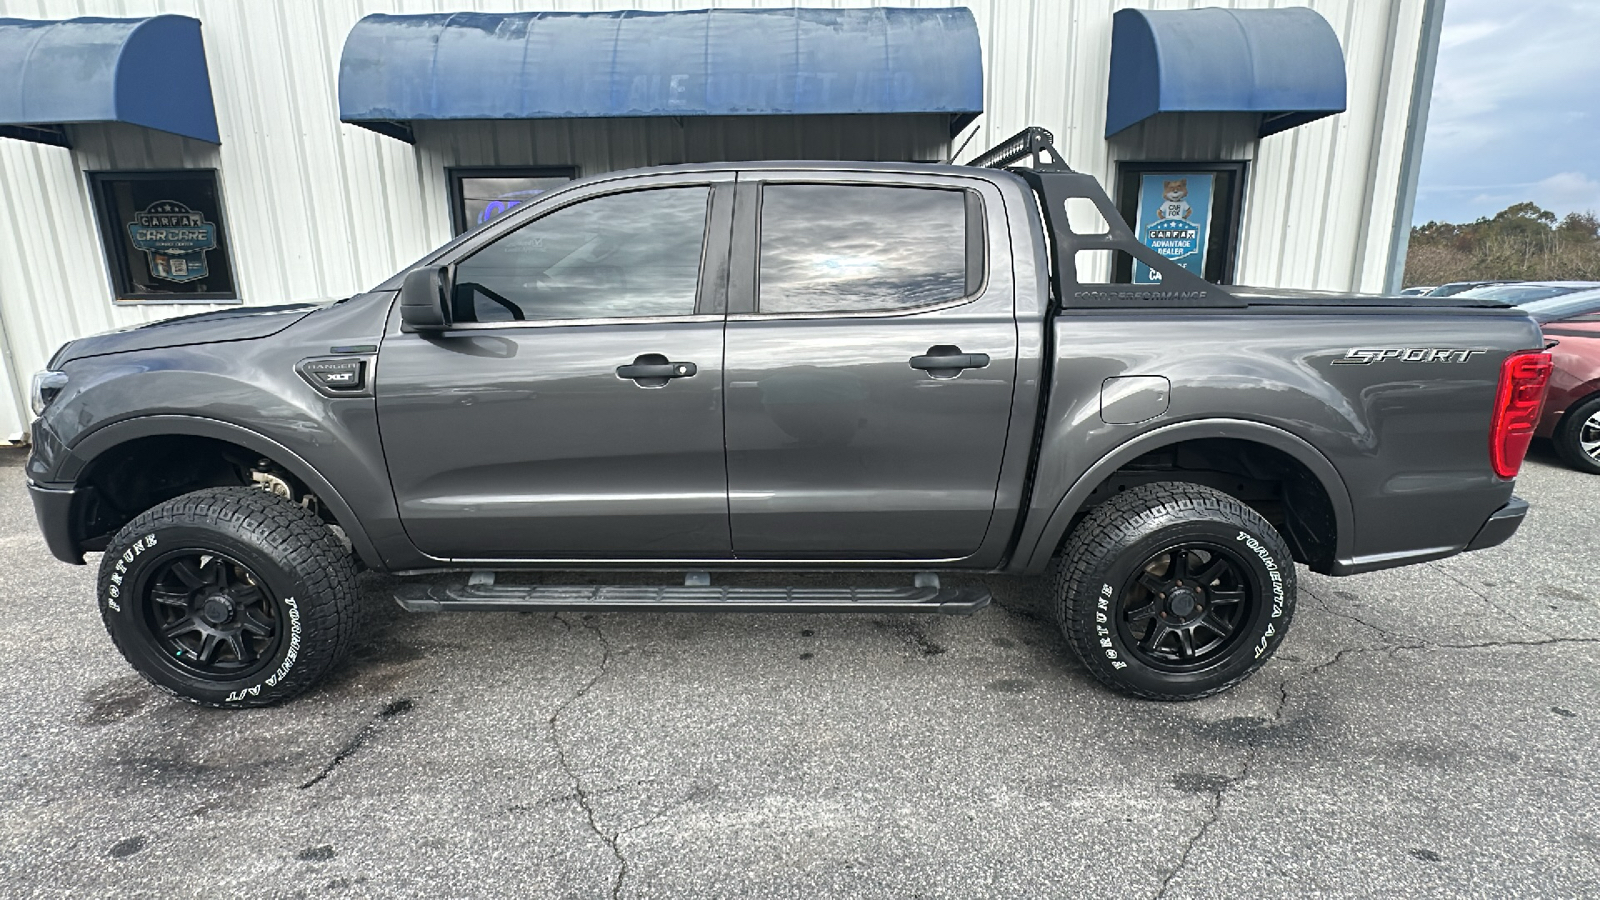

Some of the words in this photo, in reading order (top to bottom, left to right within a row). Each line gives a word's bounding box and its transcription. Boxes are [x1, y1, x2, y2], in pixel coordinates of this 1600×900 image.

[141, 216, 199, 226] CARFAX
[136, 229, 166, 241] CAR
[168, 229, 207, 241] CARE
[1149, 230, 1195, 239] CARFAX
[1110, 290, 1208, 301] PERFORMANCE
[1330, 347, 1488, 365] SPORT
[326, 373, 353, 381] XLT
[108, 533, 159, 612] FORTUNE
[1096, 583, 1128, 670] FORTUNE
